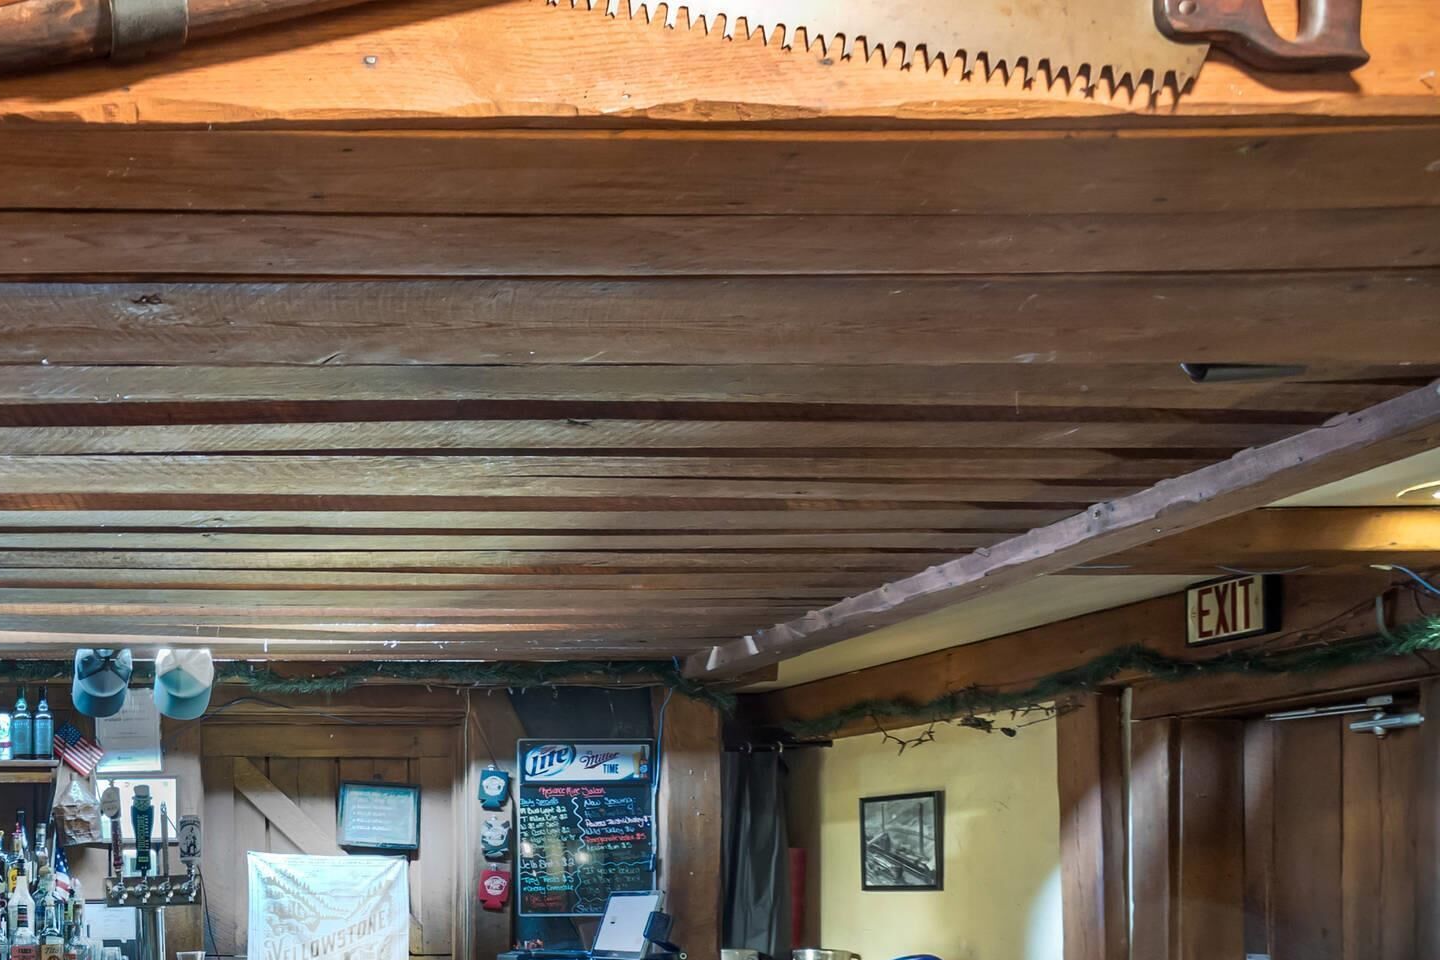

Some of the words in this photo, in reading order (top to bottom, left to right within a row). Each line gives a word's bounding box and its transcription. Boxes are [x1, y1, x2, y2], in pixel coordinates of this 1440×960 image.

[1198, 577, 1254, 638] EXIT
[529, 746, 569, 776] Lite
[580, 751, 620, 769] Miller
[603, 763, 619, 774] TIME
